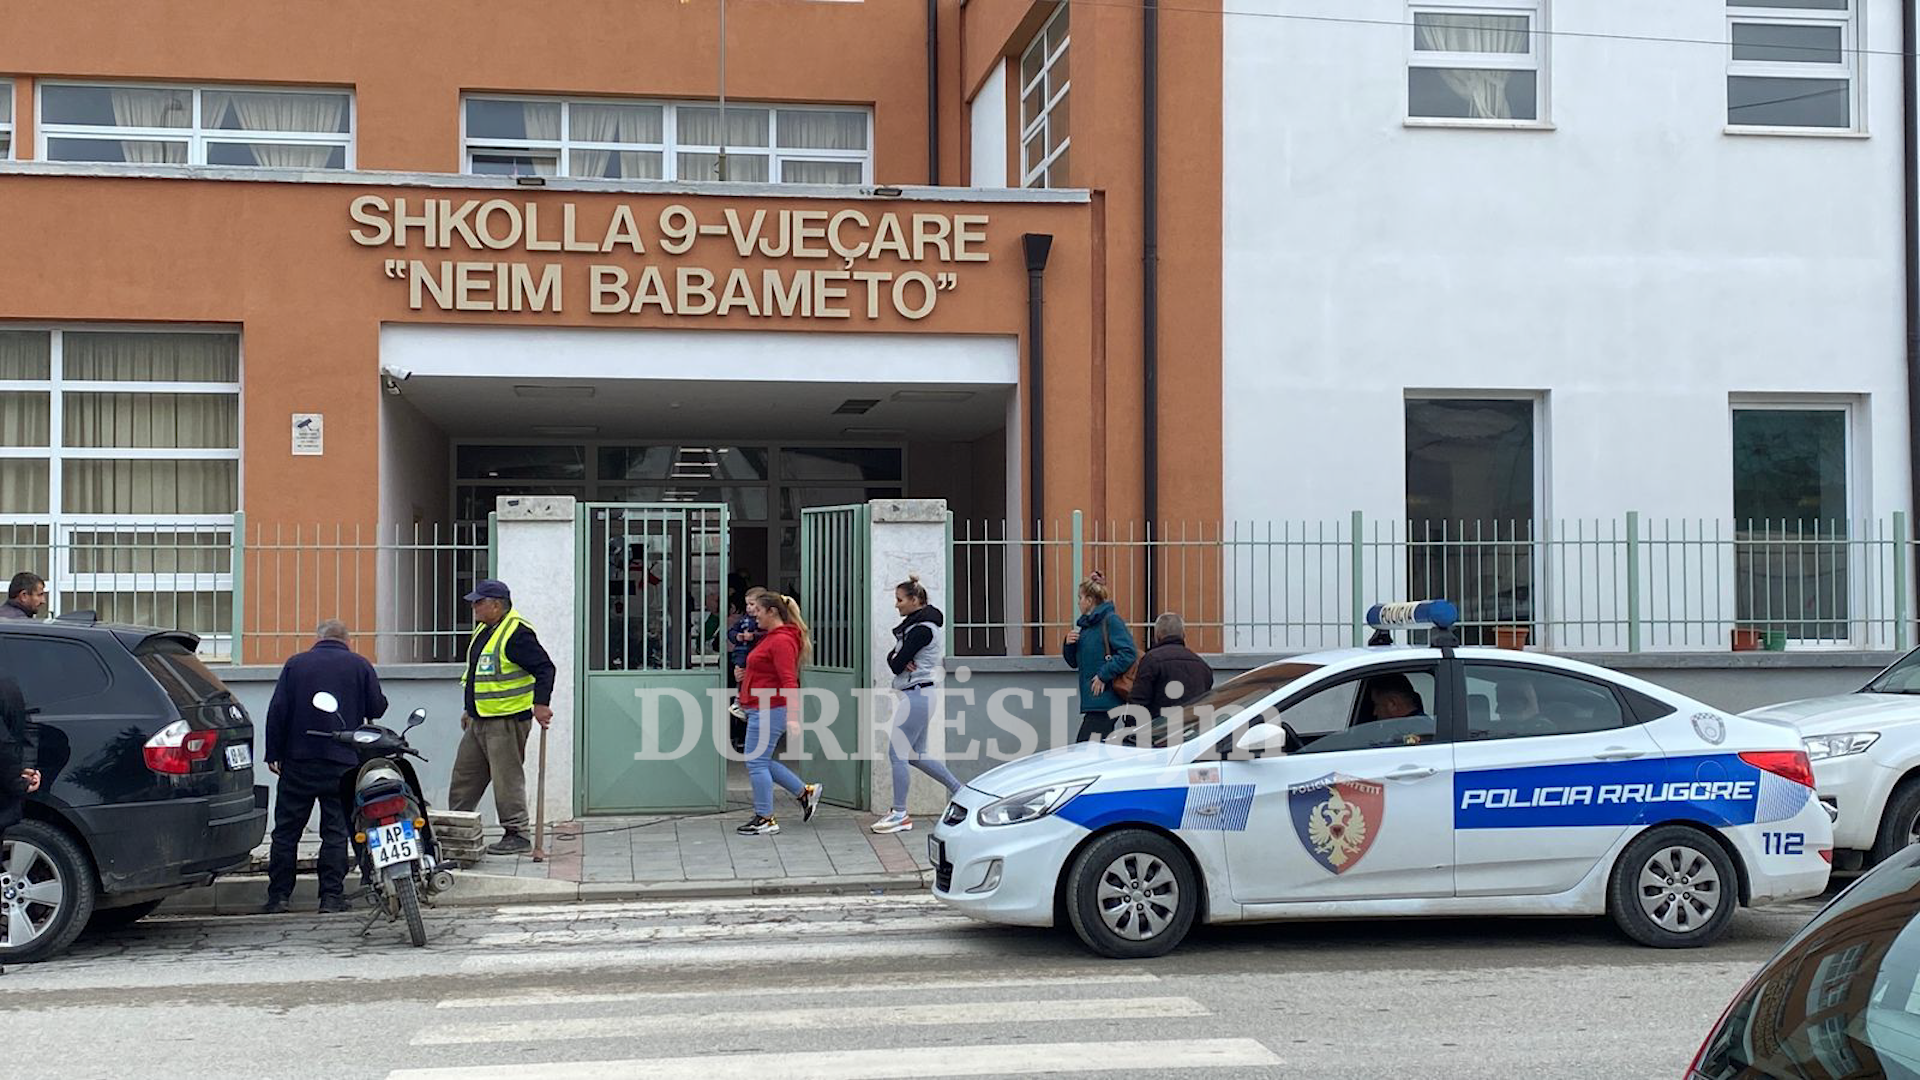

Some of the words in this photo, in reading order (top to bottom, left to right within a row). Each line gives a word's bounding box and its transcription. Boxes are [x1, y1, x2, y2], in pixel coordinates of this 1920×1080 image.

[349, 194, 646, 254] SHKOLLA
[658, 203, 990, 270] 9-VJEÇARE
[1292, 777, 1332, 795] POLICIA
[1460, 785, 1594, 810] POLICIA
[1597, 780, 1756, 805] RRUGORE
[386, 826, 402, 844] AP
[1762, 832, 1804, 855] 112
[380, 841, 411, 862] 445
